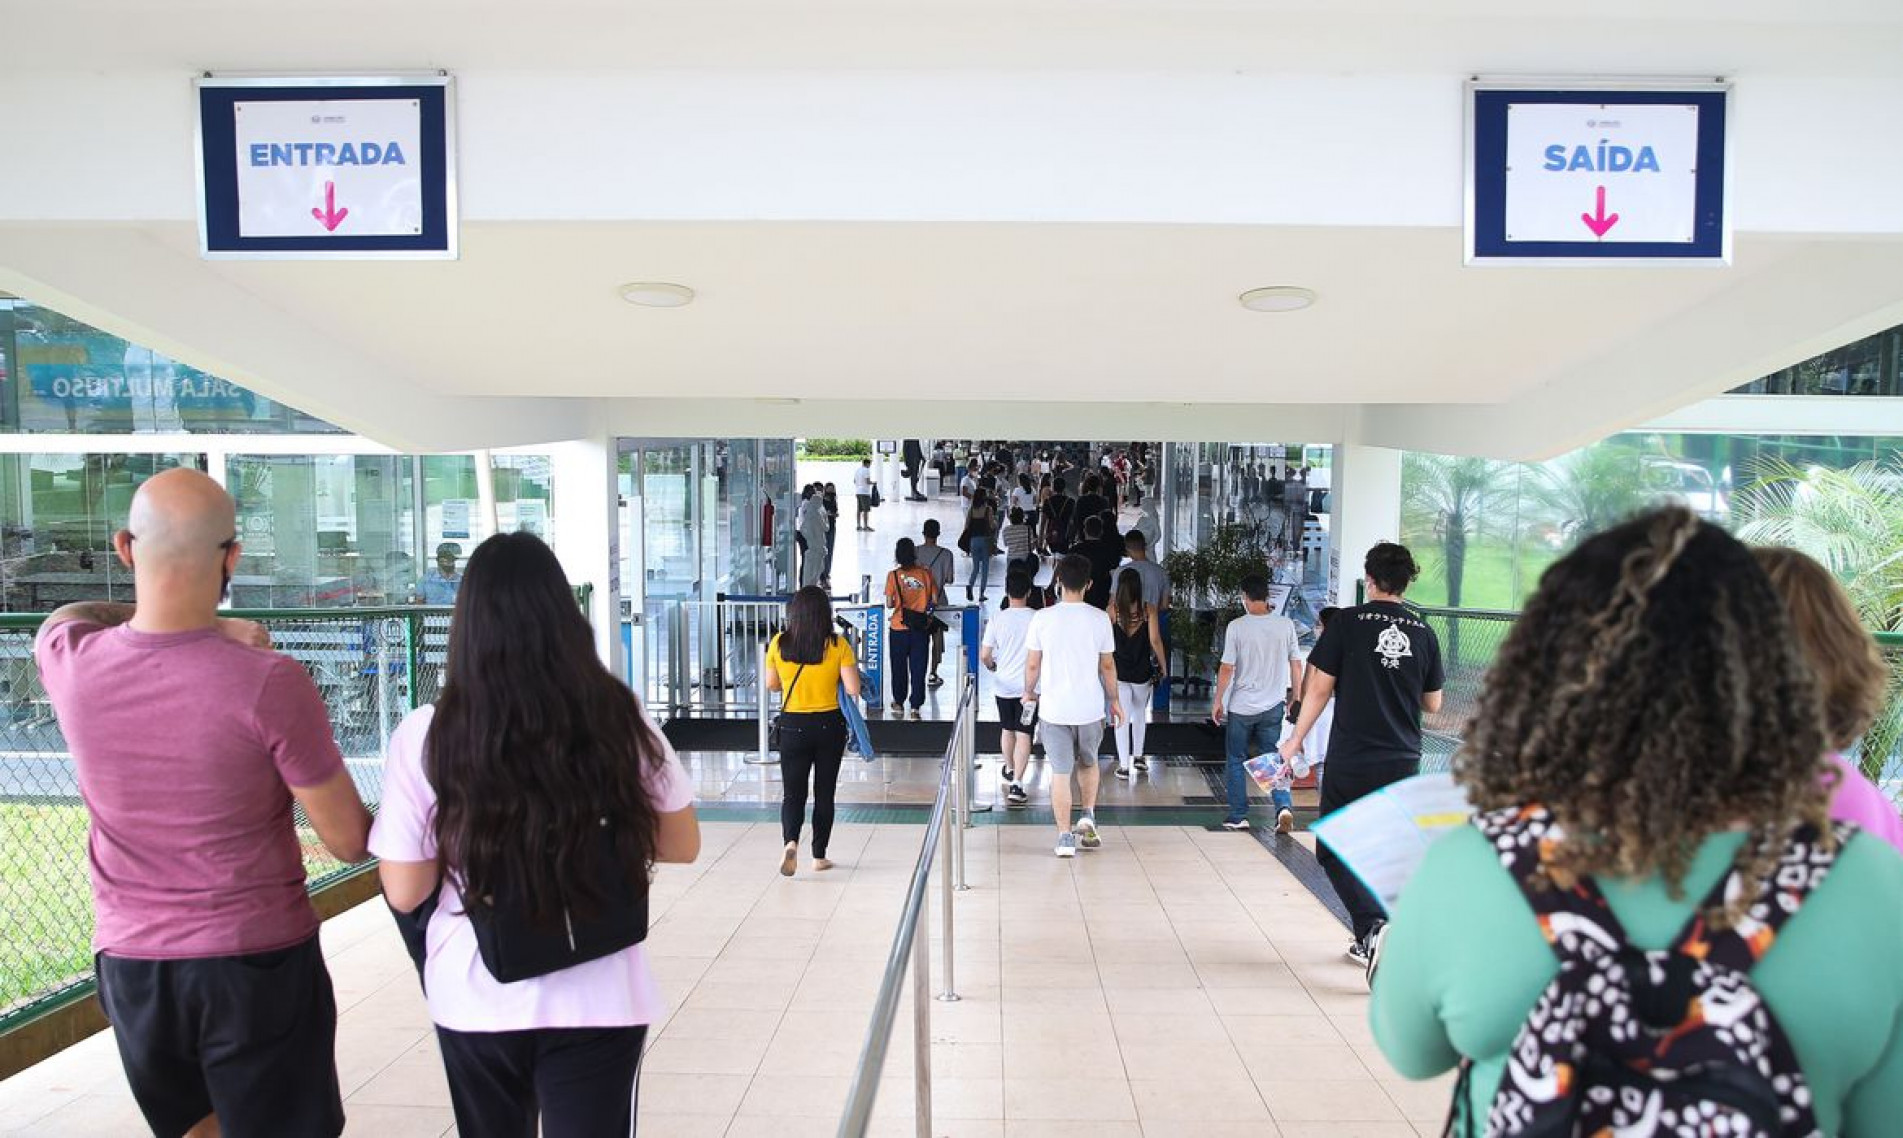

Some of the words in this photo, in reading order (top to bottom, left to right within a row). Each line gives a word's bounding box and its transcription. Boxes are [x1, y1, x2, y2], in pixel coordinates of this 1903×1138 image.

[250, 141, 406, 167] ENTRADA
[1544, 138, 1661, 172] SAÍDA
[868, 613, 879, 670] ENTRADA
